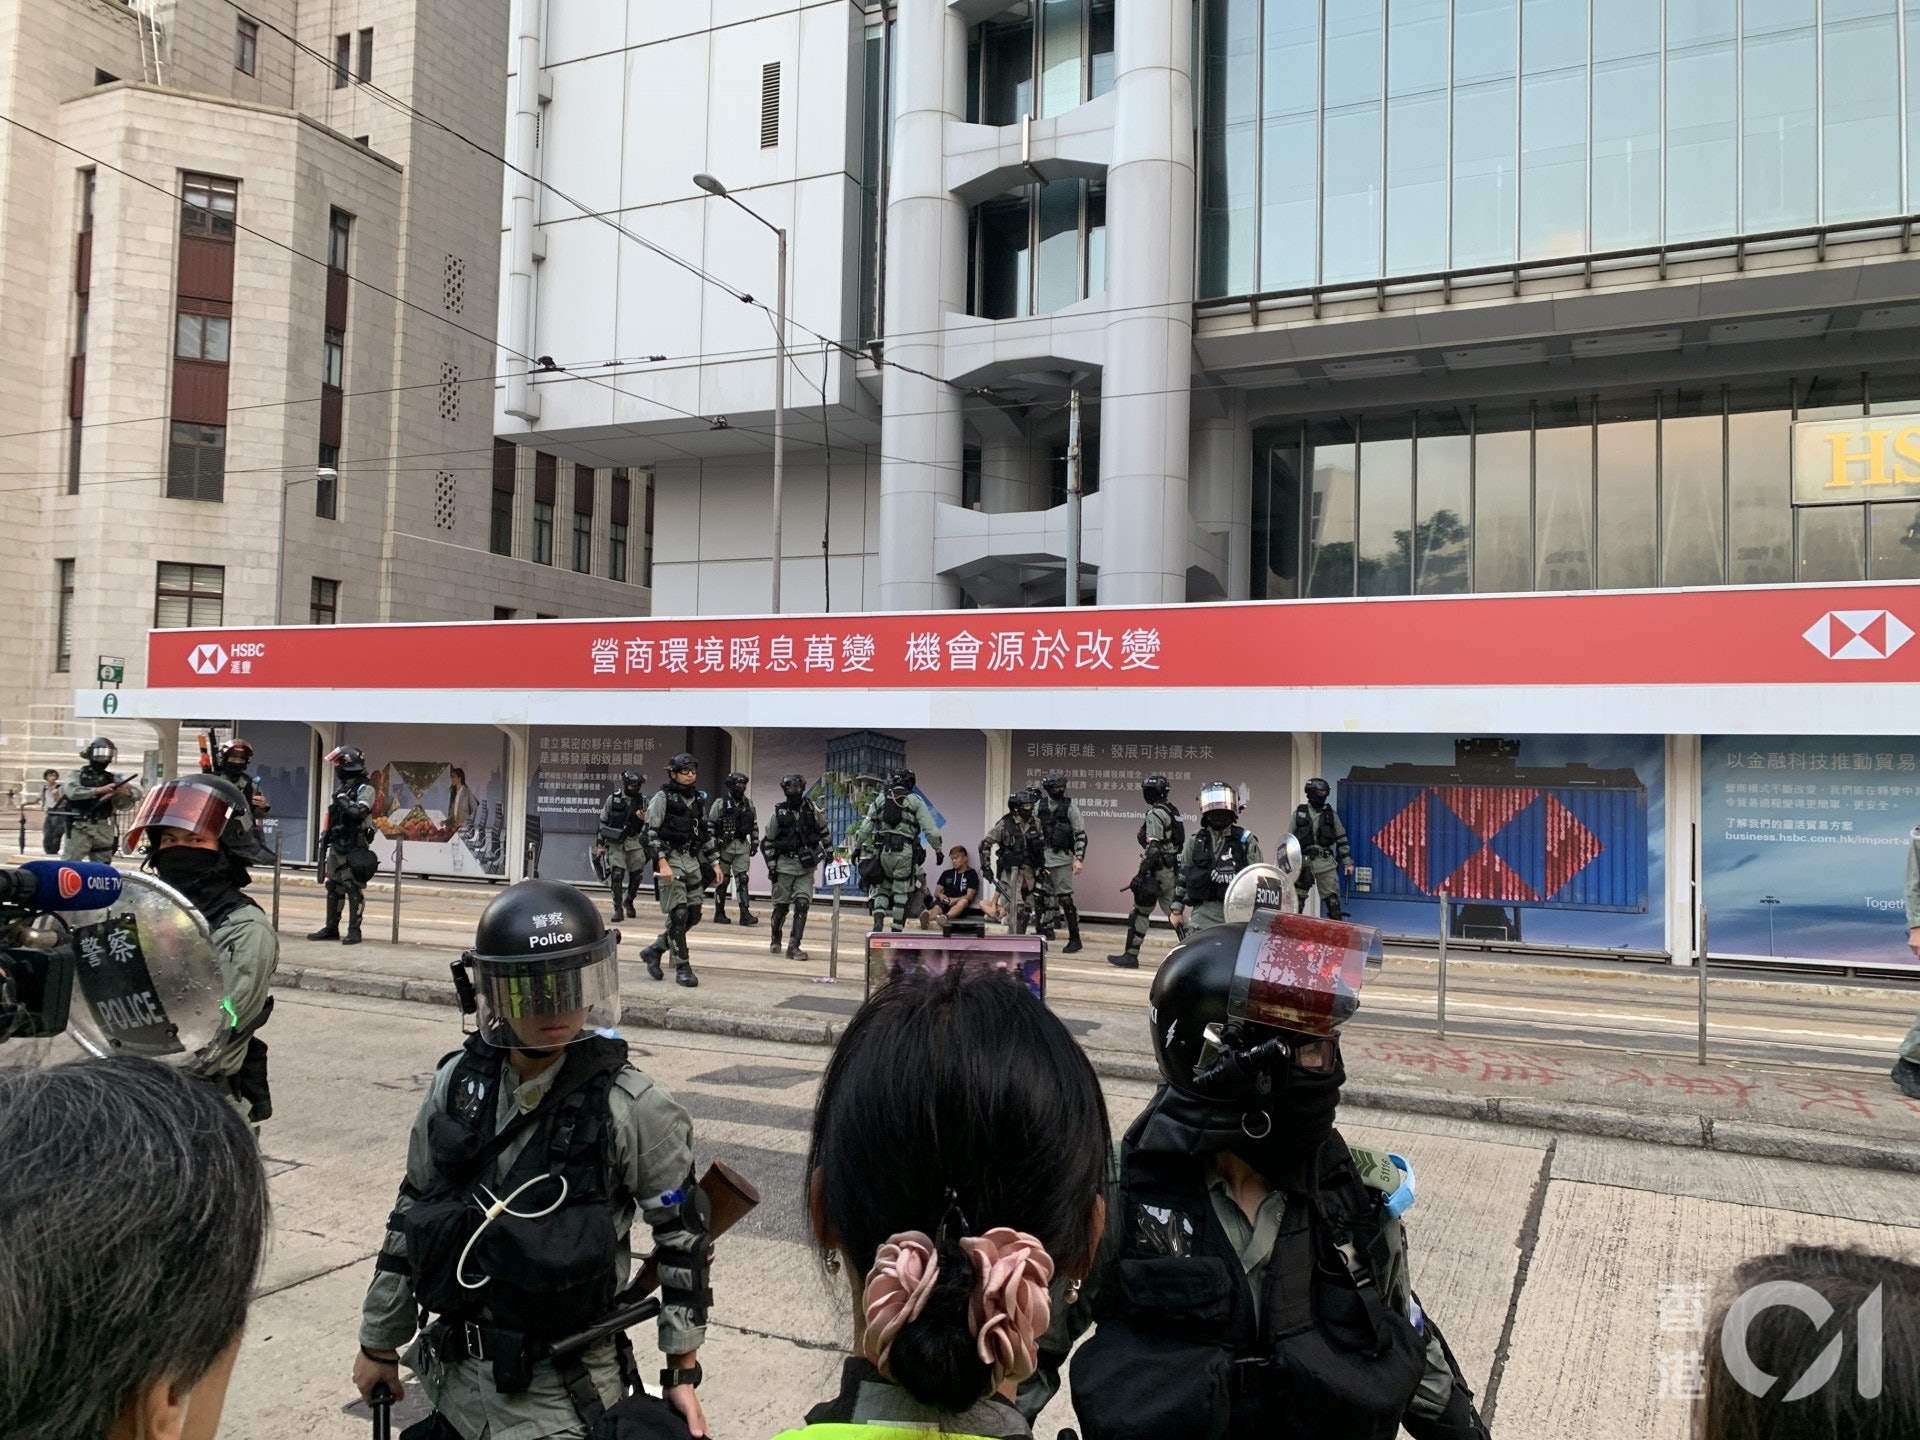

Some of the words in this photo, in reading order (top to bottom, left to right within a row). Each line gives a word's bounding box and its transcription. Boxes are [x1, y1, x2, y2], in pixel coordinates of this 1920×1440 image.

[230, 643, 265, 657] HSBC
[591, 634, 876, 675] 營商環境瞬息萬變
[904, 628, 1161, 672] 機會源於改變
[540, 751, 644, 766] 是業務發展的致勝關鍵
[1027, 743, 1215, 760] 引領新思維，發展可持續未來
[1725, 751, 1916, 771] 以金融科技推動貿易
[827, 864, 849, 881] HK
[111, 877, 122, 890] TV
[532, 911, 564, 929] 警察
[79, 928, 137, 968] 警察
[529, 932, 573, 949] Police
[97, 990, 164, 1032] POLICE
